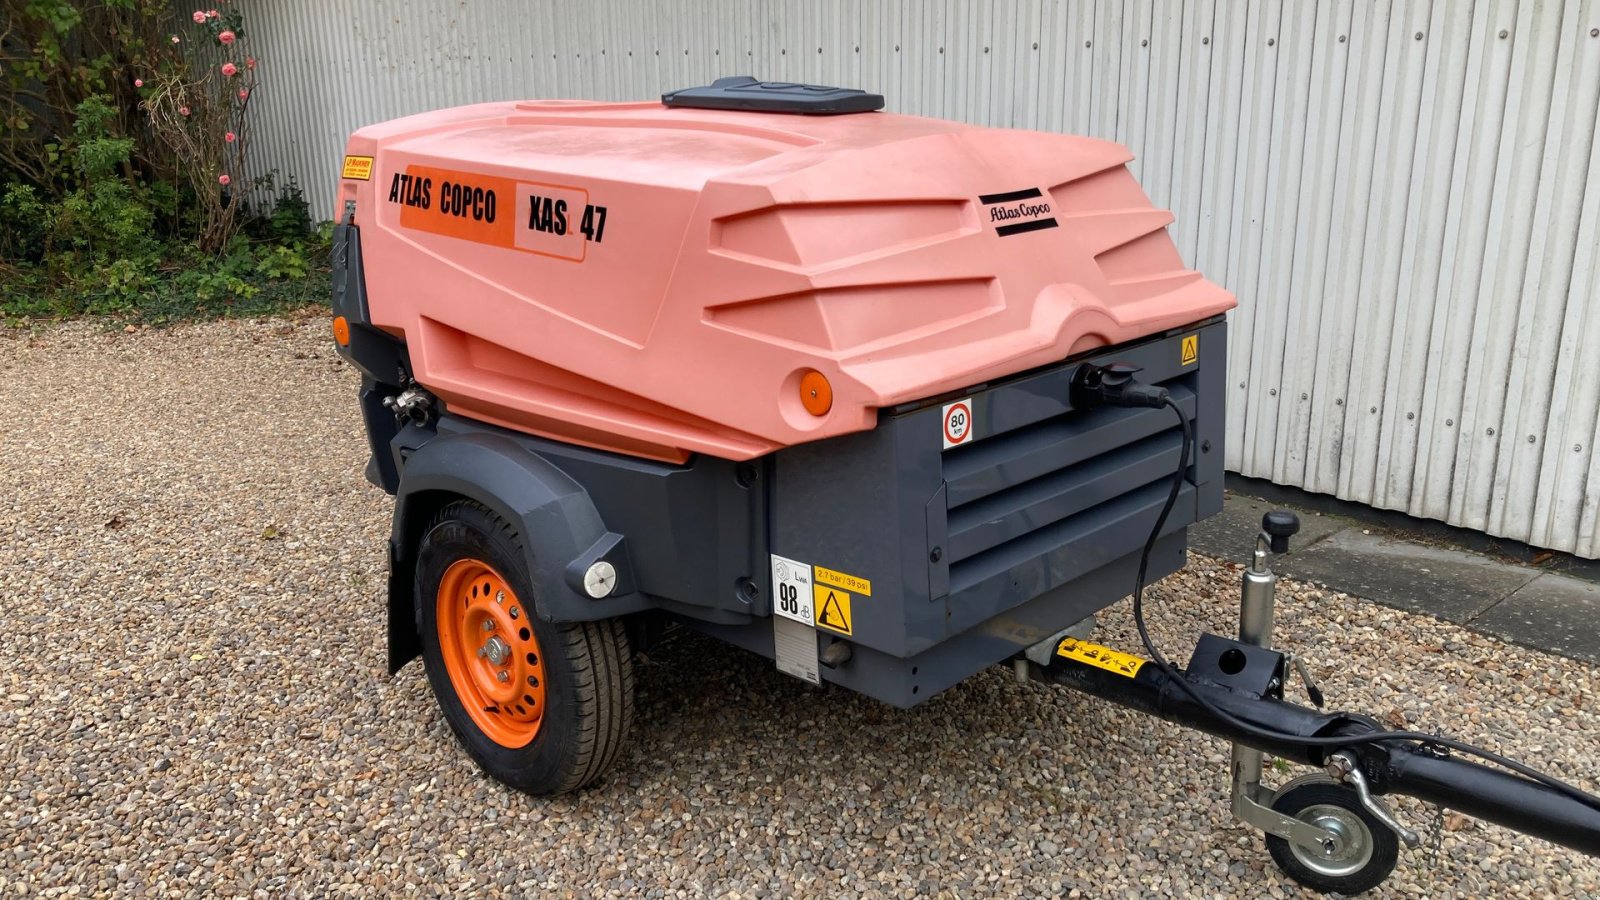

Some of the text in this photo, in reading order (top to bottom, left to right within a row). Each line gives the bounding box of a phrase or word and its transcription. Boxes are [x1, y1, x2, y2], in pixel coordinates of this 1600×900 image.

[389, 173, 607, 243] ATLAS COPCO XAS 47
[951, 413, 964, 428] 80
[818, 569, 829, 579] 2.7
[830, 574, 842, 583] bar
[847, 577, 856, 587] 39
[857, 582, 868, 591] psi
[780, 582, 798, 615] 98
[801, 605, 811, 619] dB
